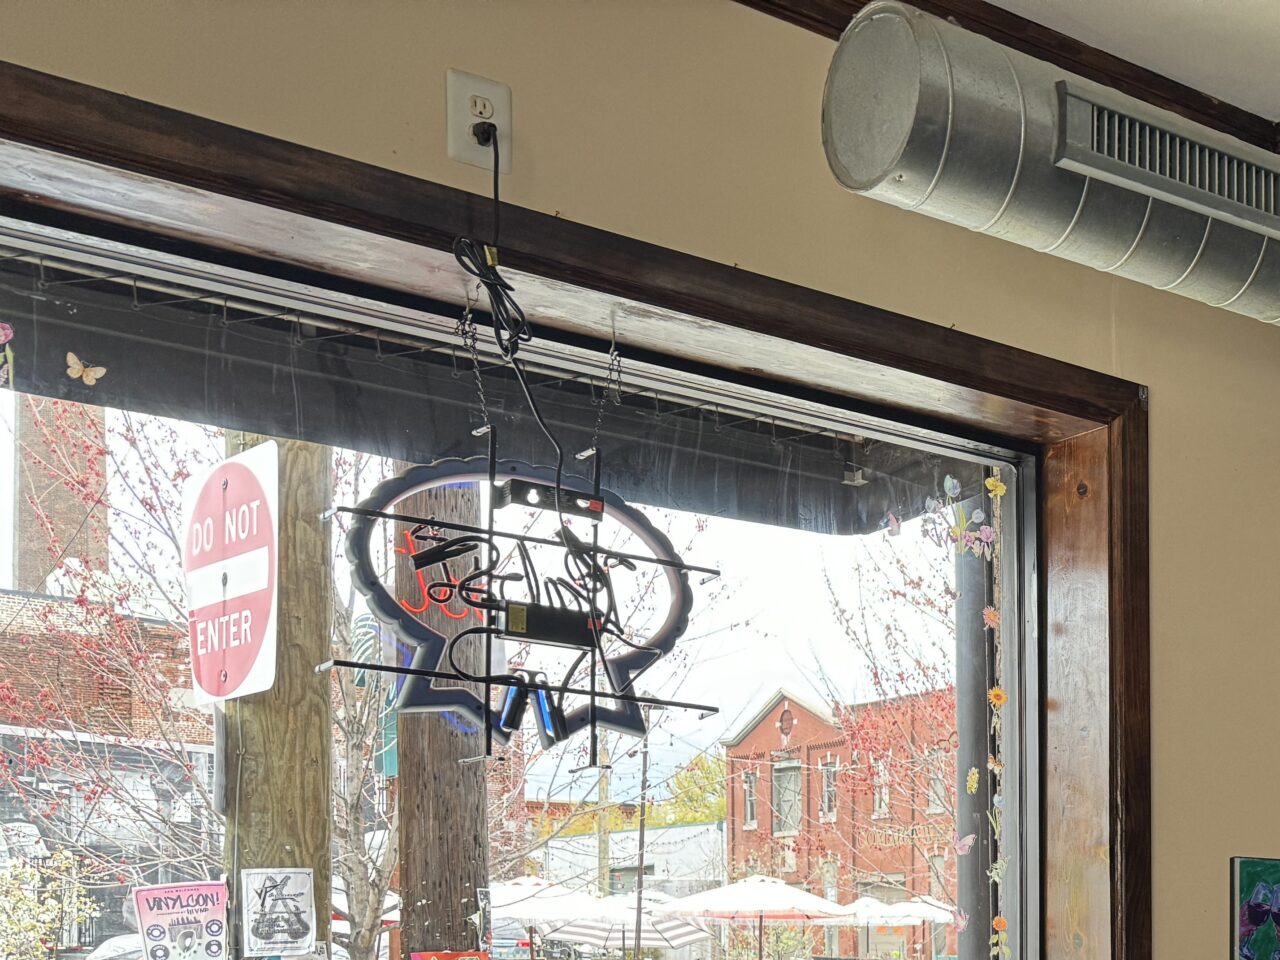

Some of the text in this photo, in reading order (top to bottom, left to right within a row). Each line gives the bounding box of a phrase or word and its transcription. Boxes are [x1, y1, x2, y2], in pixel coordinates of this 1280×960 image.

[191, 499, 261, 556] DO NOT
[196, 608, 252, 657] ENTER
[145, 891, 220, 912] VINYLCON!
